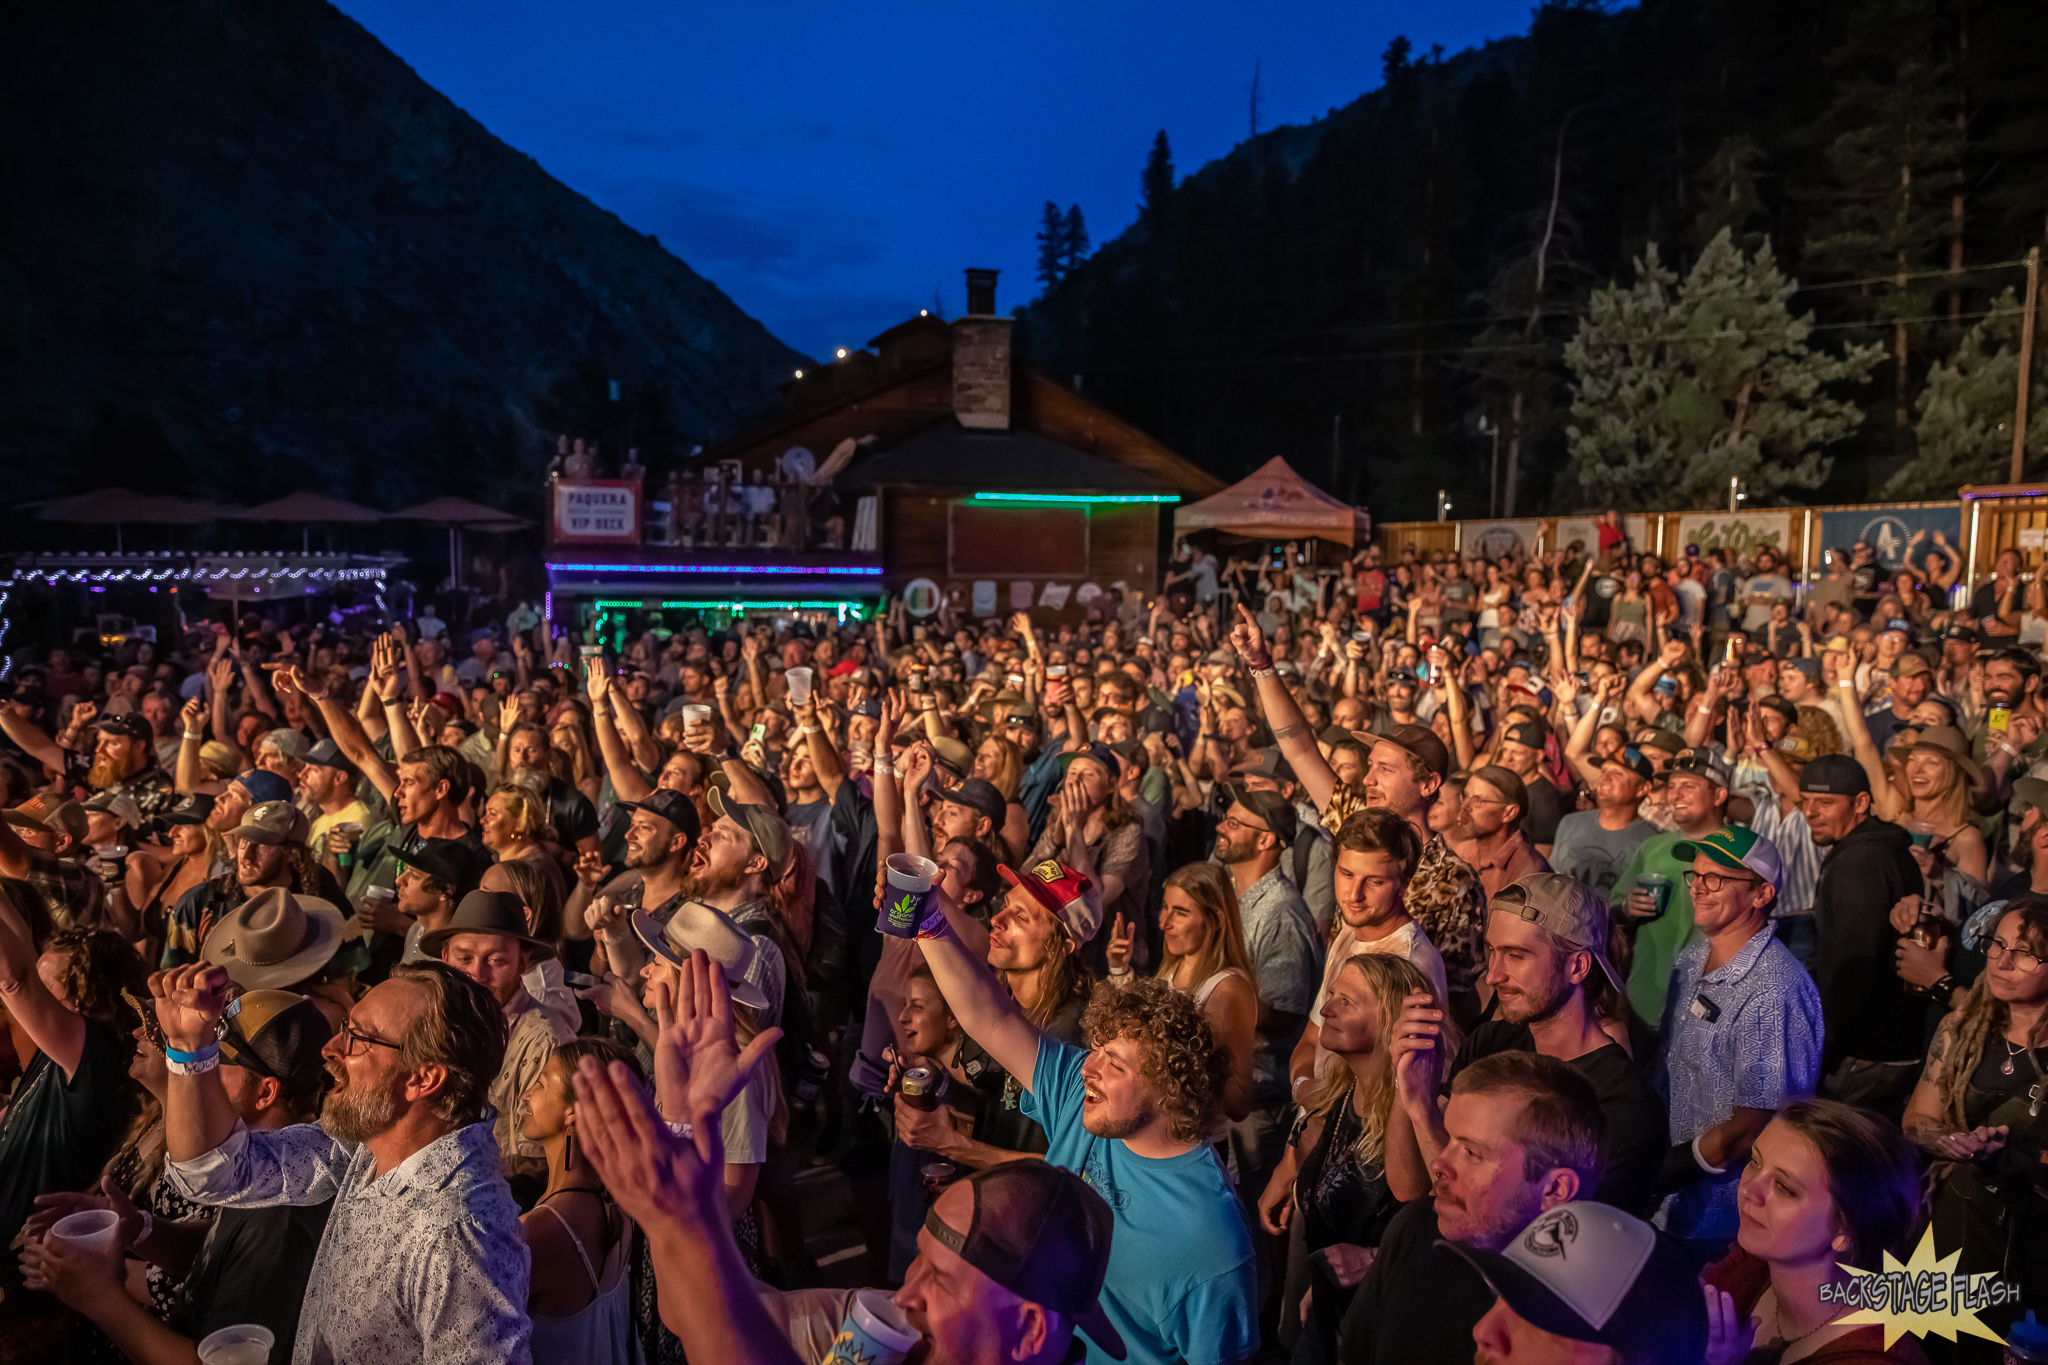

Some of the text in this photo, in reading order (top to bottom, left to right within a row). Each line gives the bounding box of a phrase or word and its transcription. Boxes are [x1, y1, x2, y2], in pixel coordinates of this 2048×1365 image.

[568, 492, 627, 506] PAQUERA
[571, 517, 624, 530] VIP DECK
